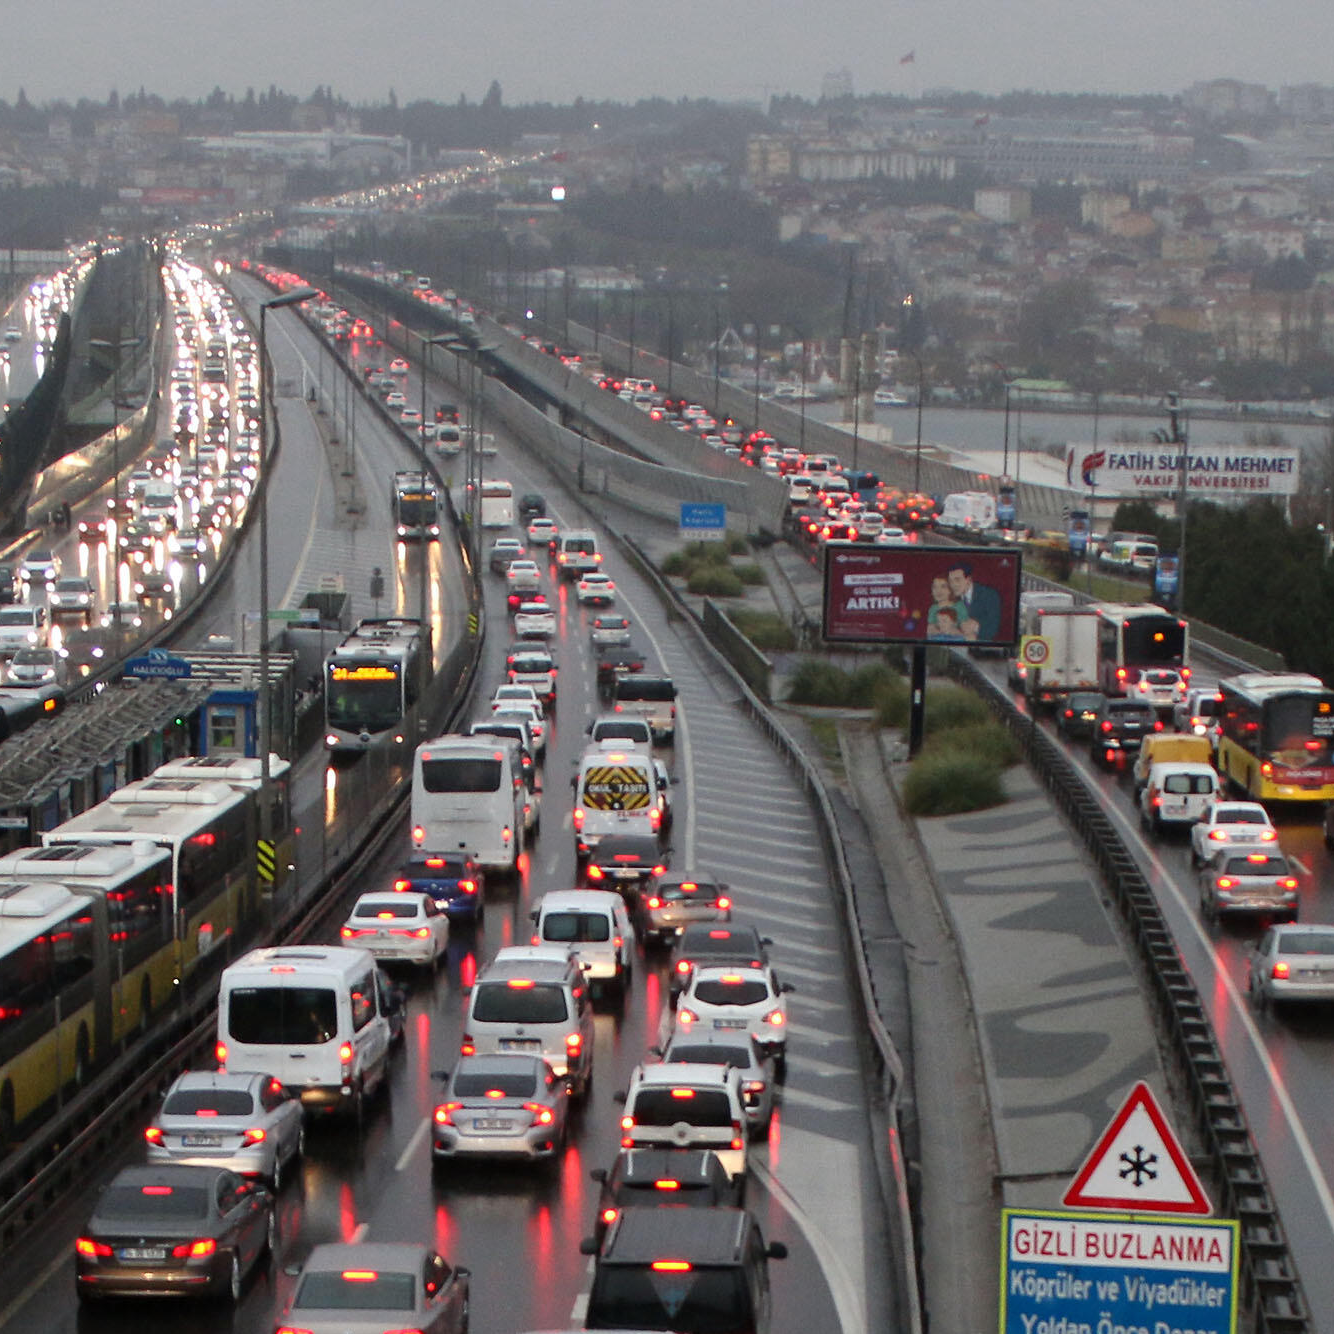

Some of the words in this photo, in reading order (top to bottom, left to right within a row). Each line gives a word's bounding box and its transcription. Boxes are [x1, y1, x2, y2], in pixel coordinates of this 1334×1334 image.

[1109, 450, 1153, 470] FATİH
[1158, 454, 1219, 472] SUTAN
[1224, 456, 1295, 473] MEHMET
[1134, 474, 1174, 486] VAKIF
[1178, 474, 1270, 488] NİVERSİTESİ
[1029, 645, 1044, 657] 50
[1014, 1223, 1077, 1258] GİZLİ
[1085, 1232, 1223, 1263] BUZLANMA
[1010, 1269, 1093, 1304] Köprüler
[1096, 1280, 1120, 1301] ve
[1124, 1275, 1226, 1310] Viyadükler
